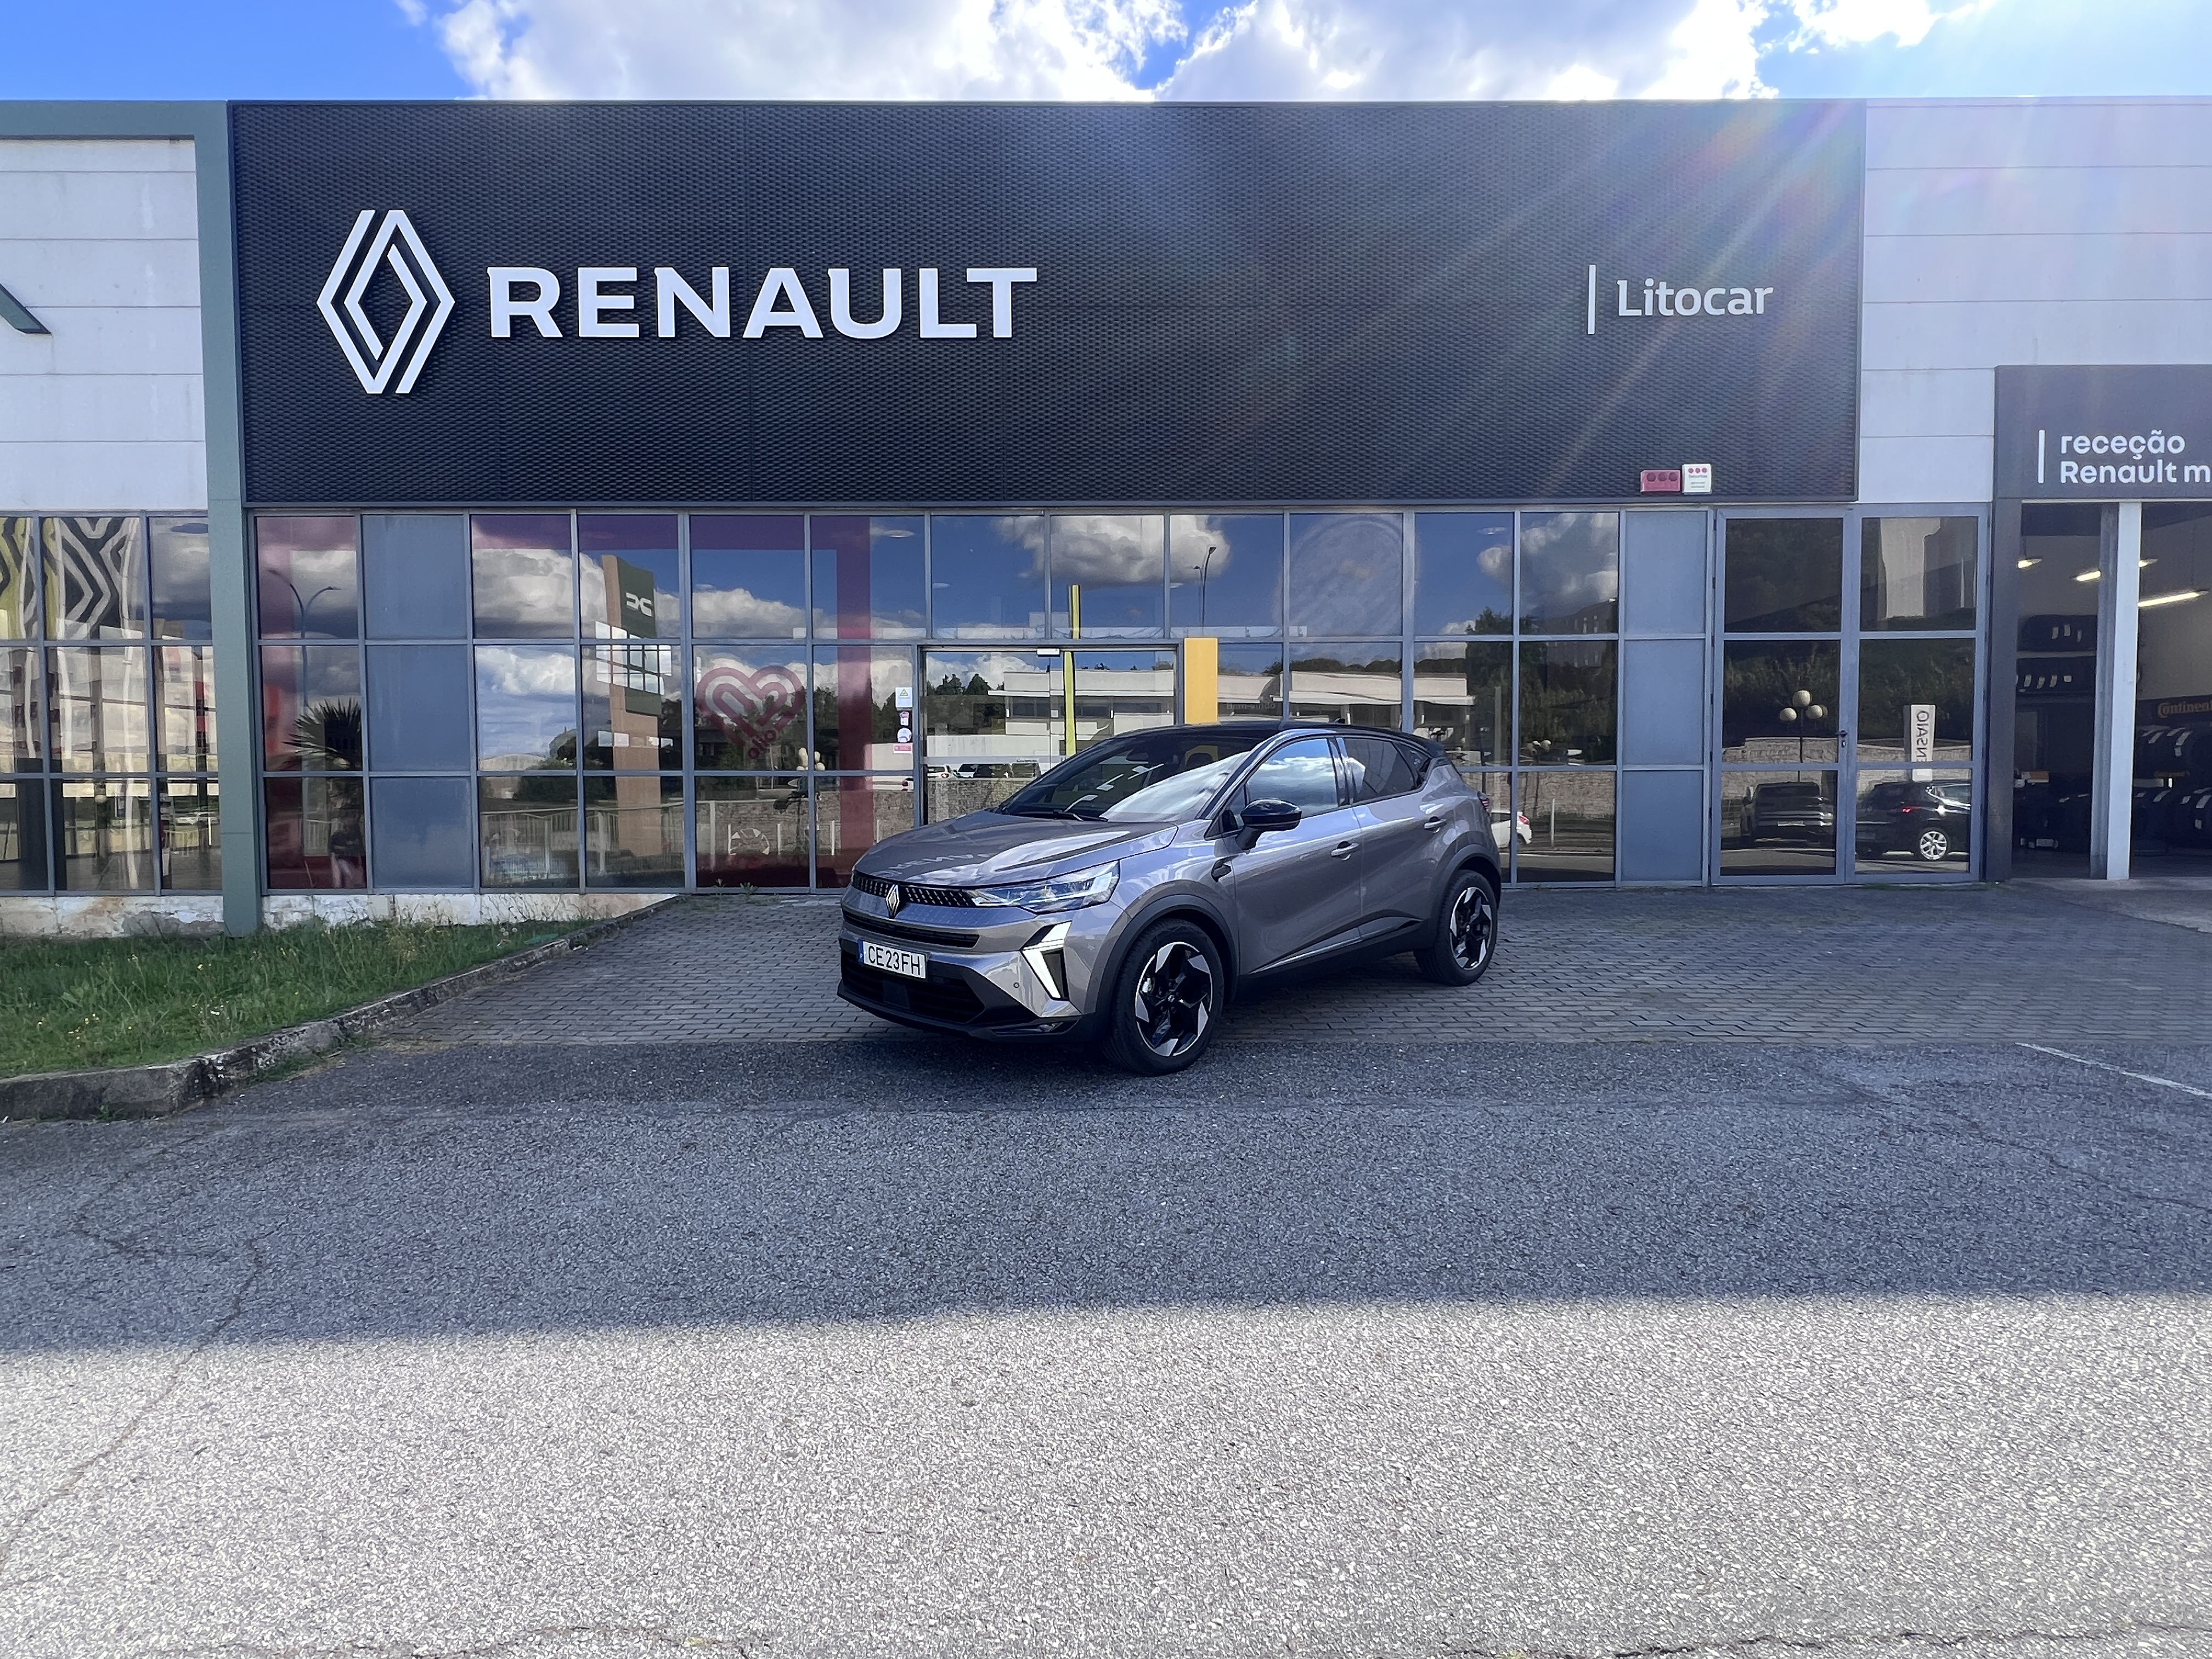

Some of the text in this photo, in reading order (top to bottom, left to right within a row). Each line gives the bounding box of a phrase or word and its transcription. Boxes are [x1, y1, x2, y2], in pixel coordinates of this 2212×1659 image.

[487, 267, 1037, 339] RENAULT
[1617, 278, 1774, 317] Litocar
[2061, 430, 2186, 460] receção
[2060, 459, 2211, 484] Renault m
[868, 945, 921, 975] CE23FH
